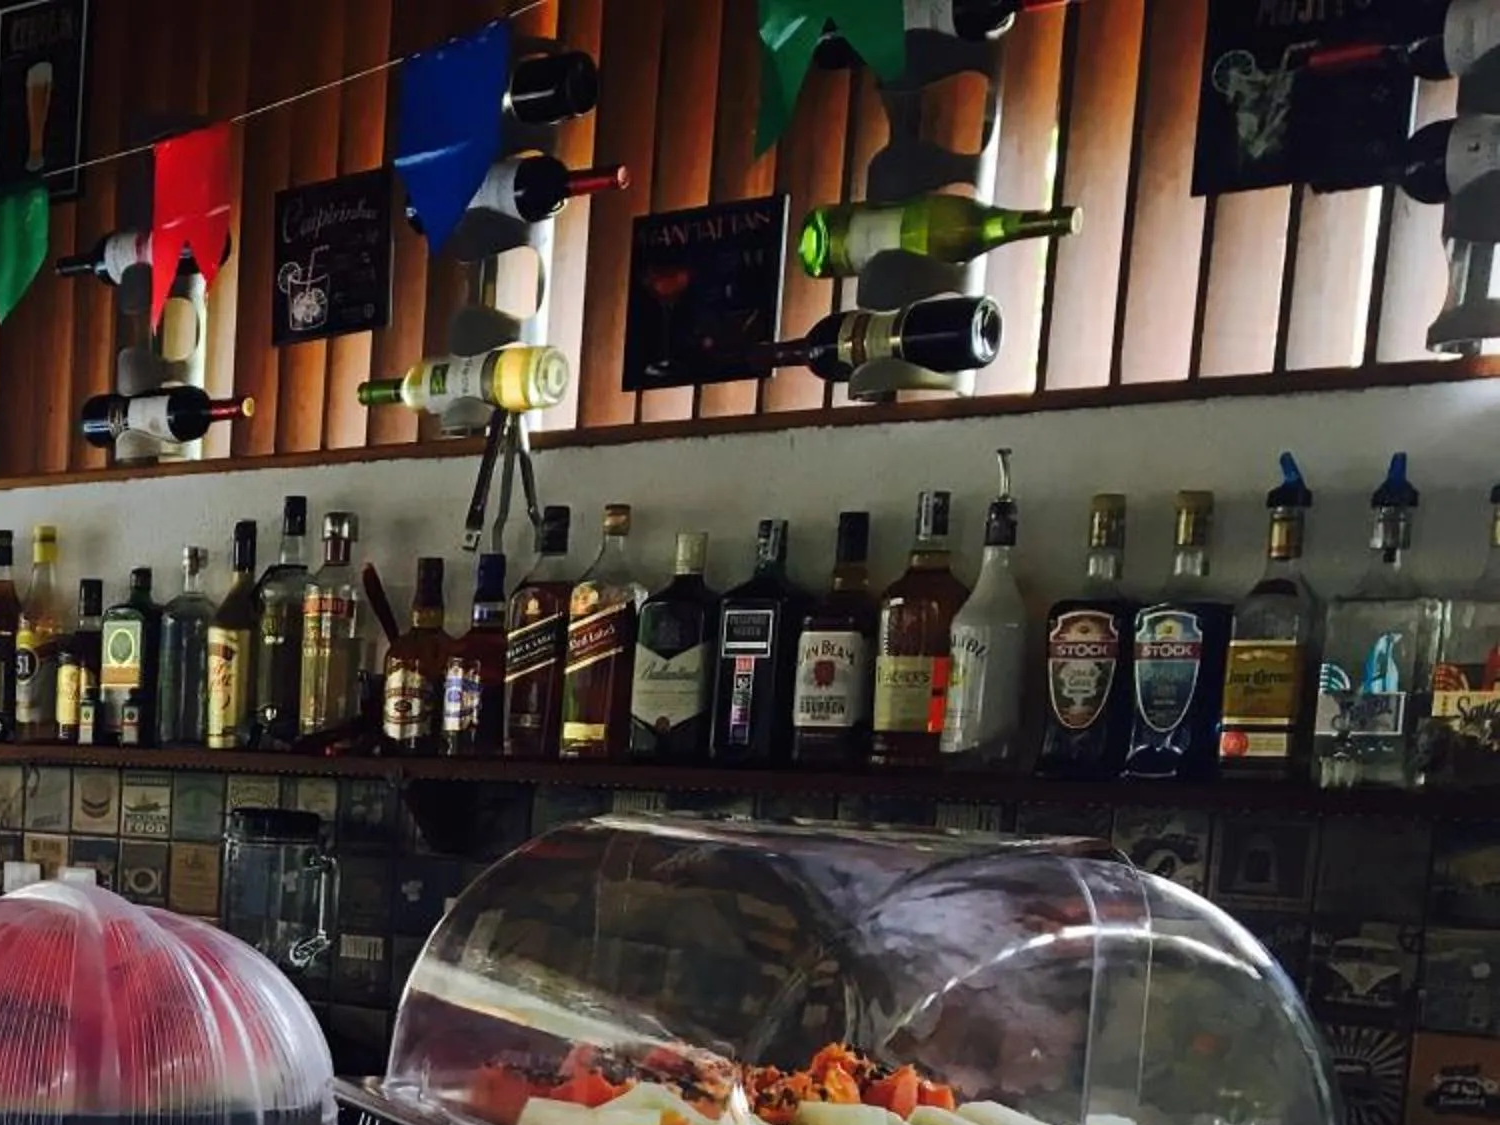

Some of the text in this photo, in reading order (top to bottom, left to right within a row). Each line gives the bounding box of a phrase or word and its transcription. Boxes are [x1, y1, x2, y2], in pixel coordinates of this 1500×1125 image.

[1057, 644, 1108, 657] STOCK
[1141, 644, 1194, 657] STOCK
[16, 656, 30, 674] 51
